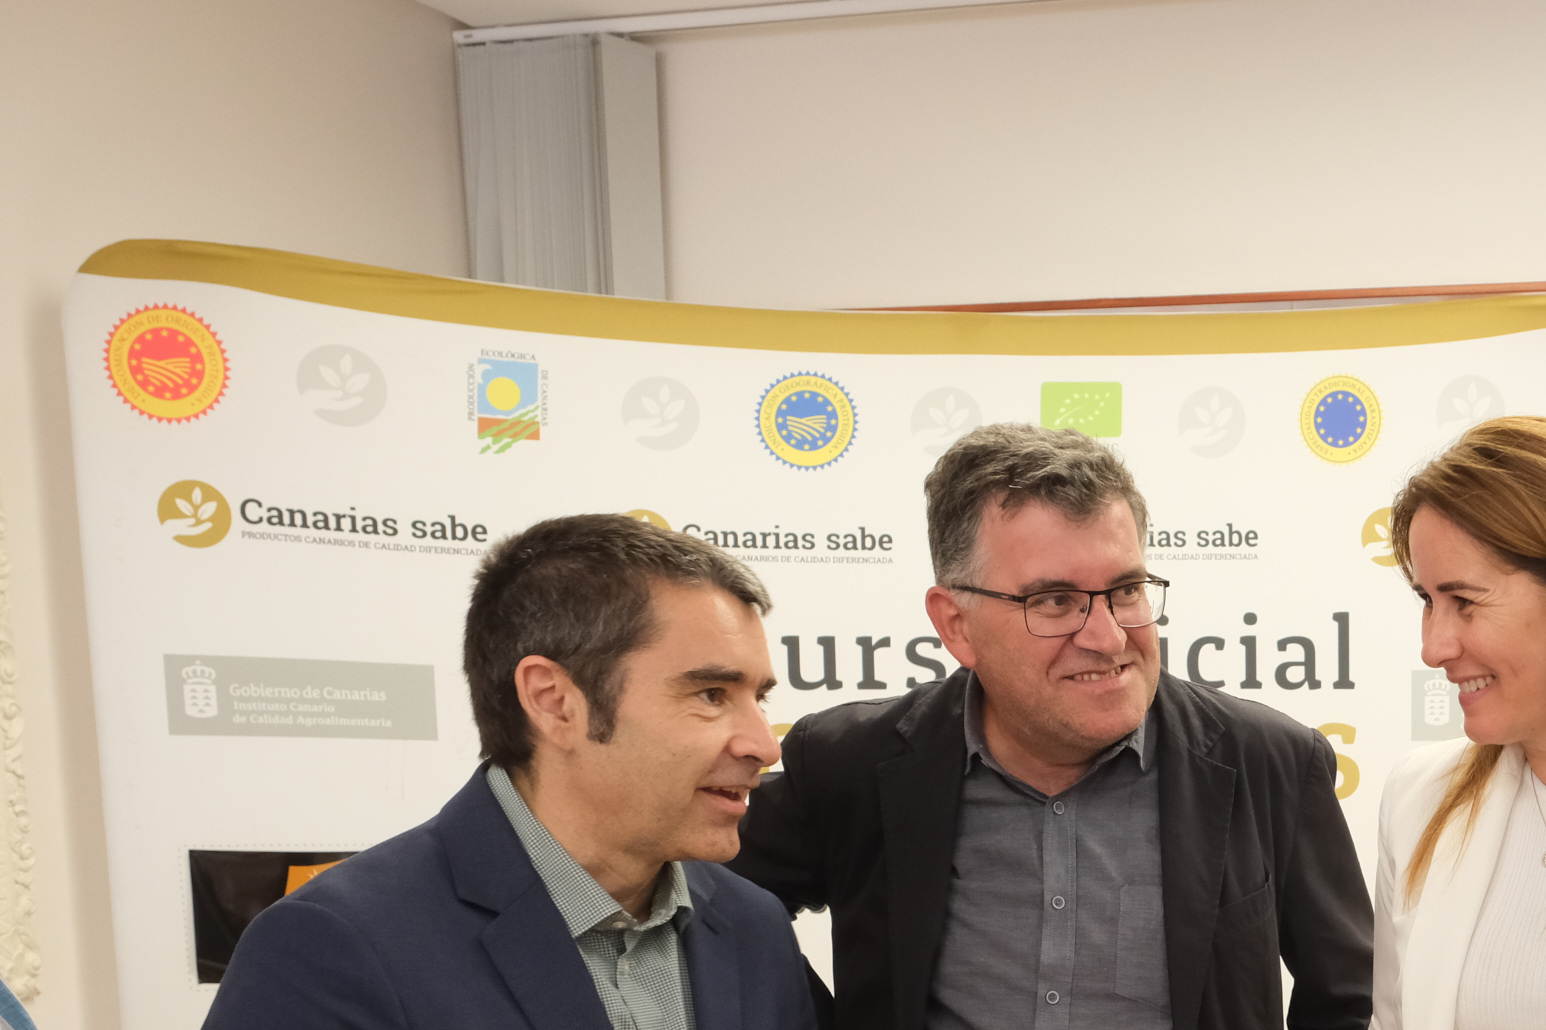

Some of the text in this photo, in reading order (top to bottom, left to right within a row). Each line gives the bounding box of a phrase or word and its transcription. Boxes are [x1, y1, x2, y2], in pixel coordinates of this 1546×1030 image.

[480, 348, 537, 362] ECOLÓGICA
[466, 362, 476, 422] PRODUCCIÓN
[763, 378, 850, 450] INDICACIÓN GEOGRÁFICA PROTEGIDA
[1304, 380, 1377, 455] ESPECIALIDAD TRADICIONAL GARANTIZADA
[239, 498, 488, 542] Canarias sabe
[241, 530, 302, 543] PRODUCTOS
[304, 535, 357, 548] CANARIOS
[358, 541, 372, 549] DE
[374, 542, 417, 553] CALIDAD
[826, 527, 894, 551] sabe
[1196, 523, 1259, 548] sabe
[794, 556, 831, 564] CALIDAD
[229, 683, 387, 701] Gobierno de Canarias
[234, 701, 335, 713] Instituto Canario
[232, 714, 392, 727] de Calidad Agroalimentaria
